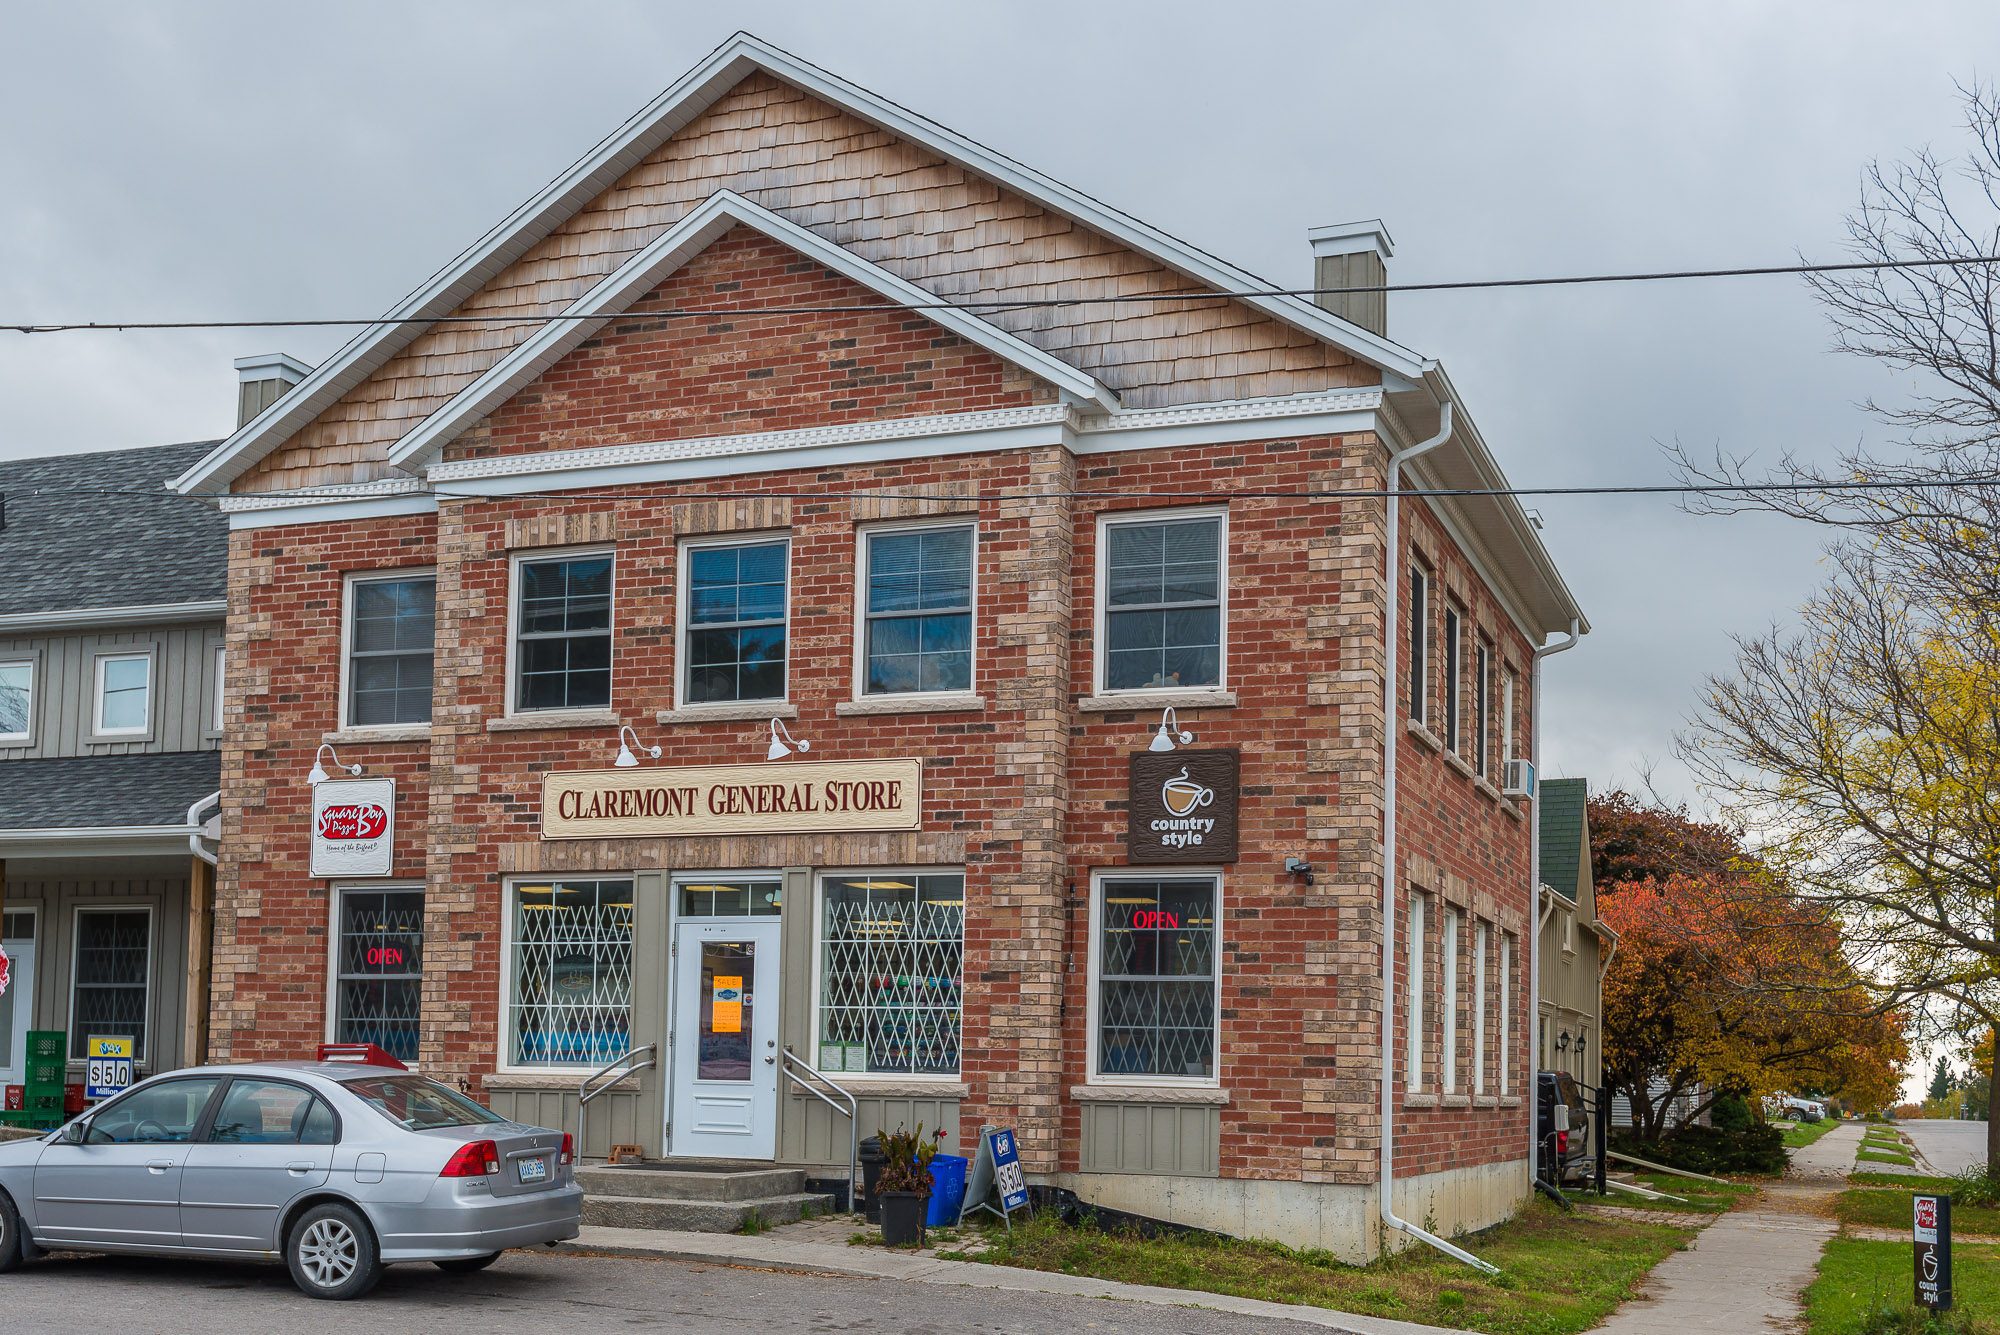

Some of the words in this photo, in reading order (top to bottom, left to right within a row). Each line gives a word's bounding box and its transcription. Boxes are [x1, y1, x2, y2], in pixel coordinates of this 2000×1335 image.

[558, 787, 699, 820] CLAREMONT
[707, 783, 819, 816] GENERAL
[824, 780, 902, 813] STORE
[317, 802, 358, 837] Square
[356, 803, 384, 837] Boy
[332, 820, 356, 836] Pizza
[1150, 816, 1215, 834] country
[347, 843, 355, 851] the
[1161, 830, 1203, 849] style
[1133, 910, 1179, 929] OPEN
[367, 947, 403, 965] OPEN
[100, 1042, 122, 1055] MAX
[1007, 1195, 1022, 1206] Million
[1919, 1280, 1938, 1292] count
